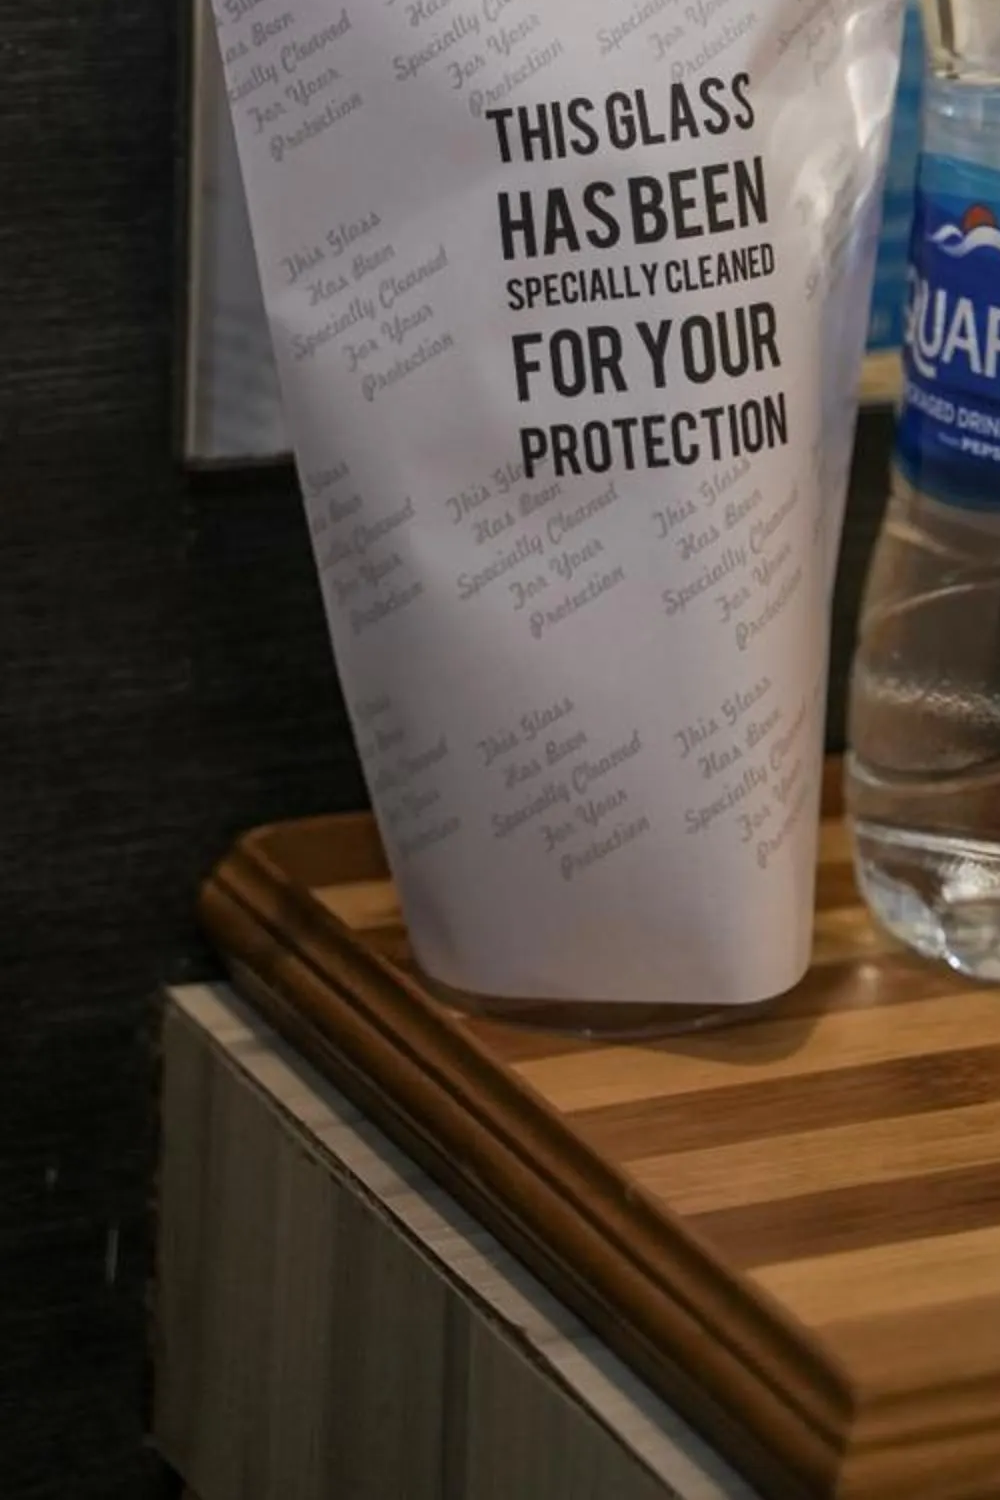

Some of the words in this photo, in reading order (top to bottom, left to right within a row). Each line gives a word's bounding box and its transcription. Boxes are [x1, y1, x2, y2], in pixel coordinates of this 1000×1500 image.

[391, 13, 481, 83] Specially
[445, 53, 486, 91] For
[485, 13, 542, 58] Your
[468, 36, 566, 119] Protection
[645, 25, 686, 62] For
[486, 97, 600, 163] THIS
[604, 72, 756, 152] GLASS
[497, 181, 621, 260] HAS
[627, 156, 769, 245] BEEN
[280, 246, 325, 286] This
[325, 210, 382, 257] Glass
[305, 276, 349, 307] Has
[351, 243, 396, 280] Been
[506, 262, 659, 311] SPECIALLY
[664, 242, 776, 293] CLEANED
[290, 297, 376, 362] Specially
[378, 242, 449, 309] Cleaned
[342, 339, 379, 373] For
[380, 304, 434, 345] Your
[361, 333, 454, 403] Protection
[511, 325, 628, 402] FOR
[635, 301, 782, 389] YOUR
[519, 391, 789, 479] PROTECTION
[445, 483, 492, 526] This
[456, 533, 544, 601] Specially
[546, 479, 621, 546] Cleaned
[470, 508, 517, 546] Has
[518, 484, 562, 518] Been
[508, 575, 550, 611] For
[549, 537, 605, 581] Your
[529, 565, 628, 641] Protection
